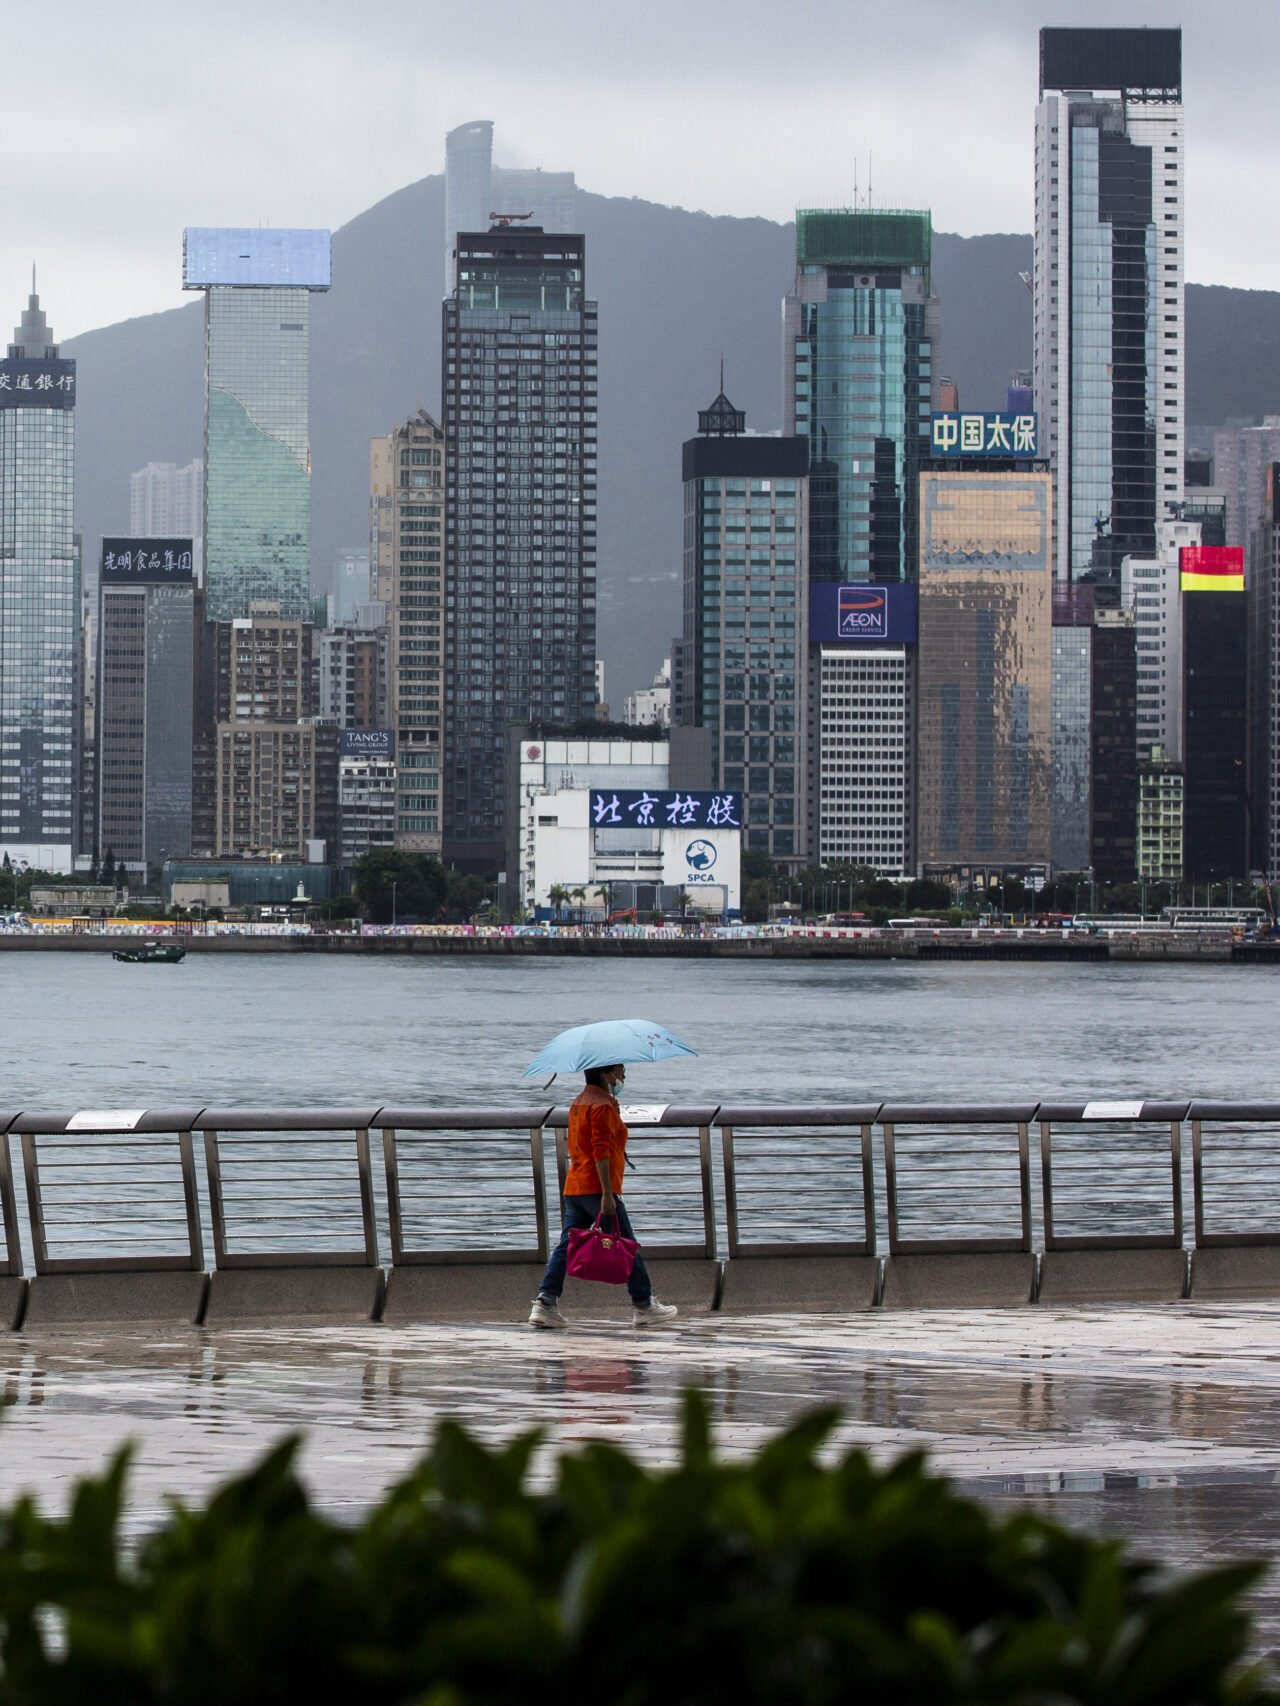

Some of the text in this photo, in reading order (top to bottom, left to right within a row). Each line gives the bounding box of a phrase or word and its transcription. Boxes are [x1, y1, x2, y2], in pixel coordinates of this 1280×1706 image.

[933, 414, 1036, 451] 中国太保
[346, 732, 389, 742] TANG'S
[592, 791, 740, 826] 北京控股
[687, 873, 716, 882] SPCA
